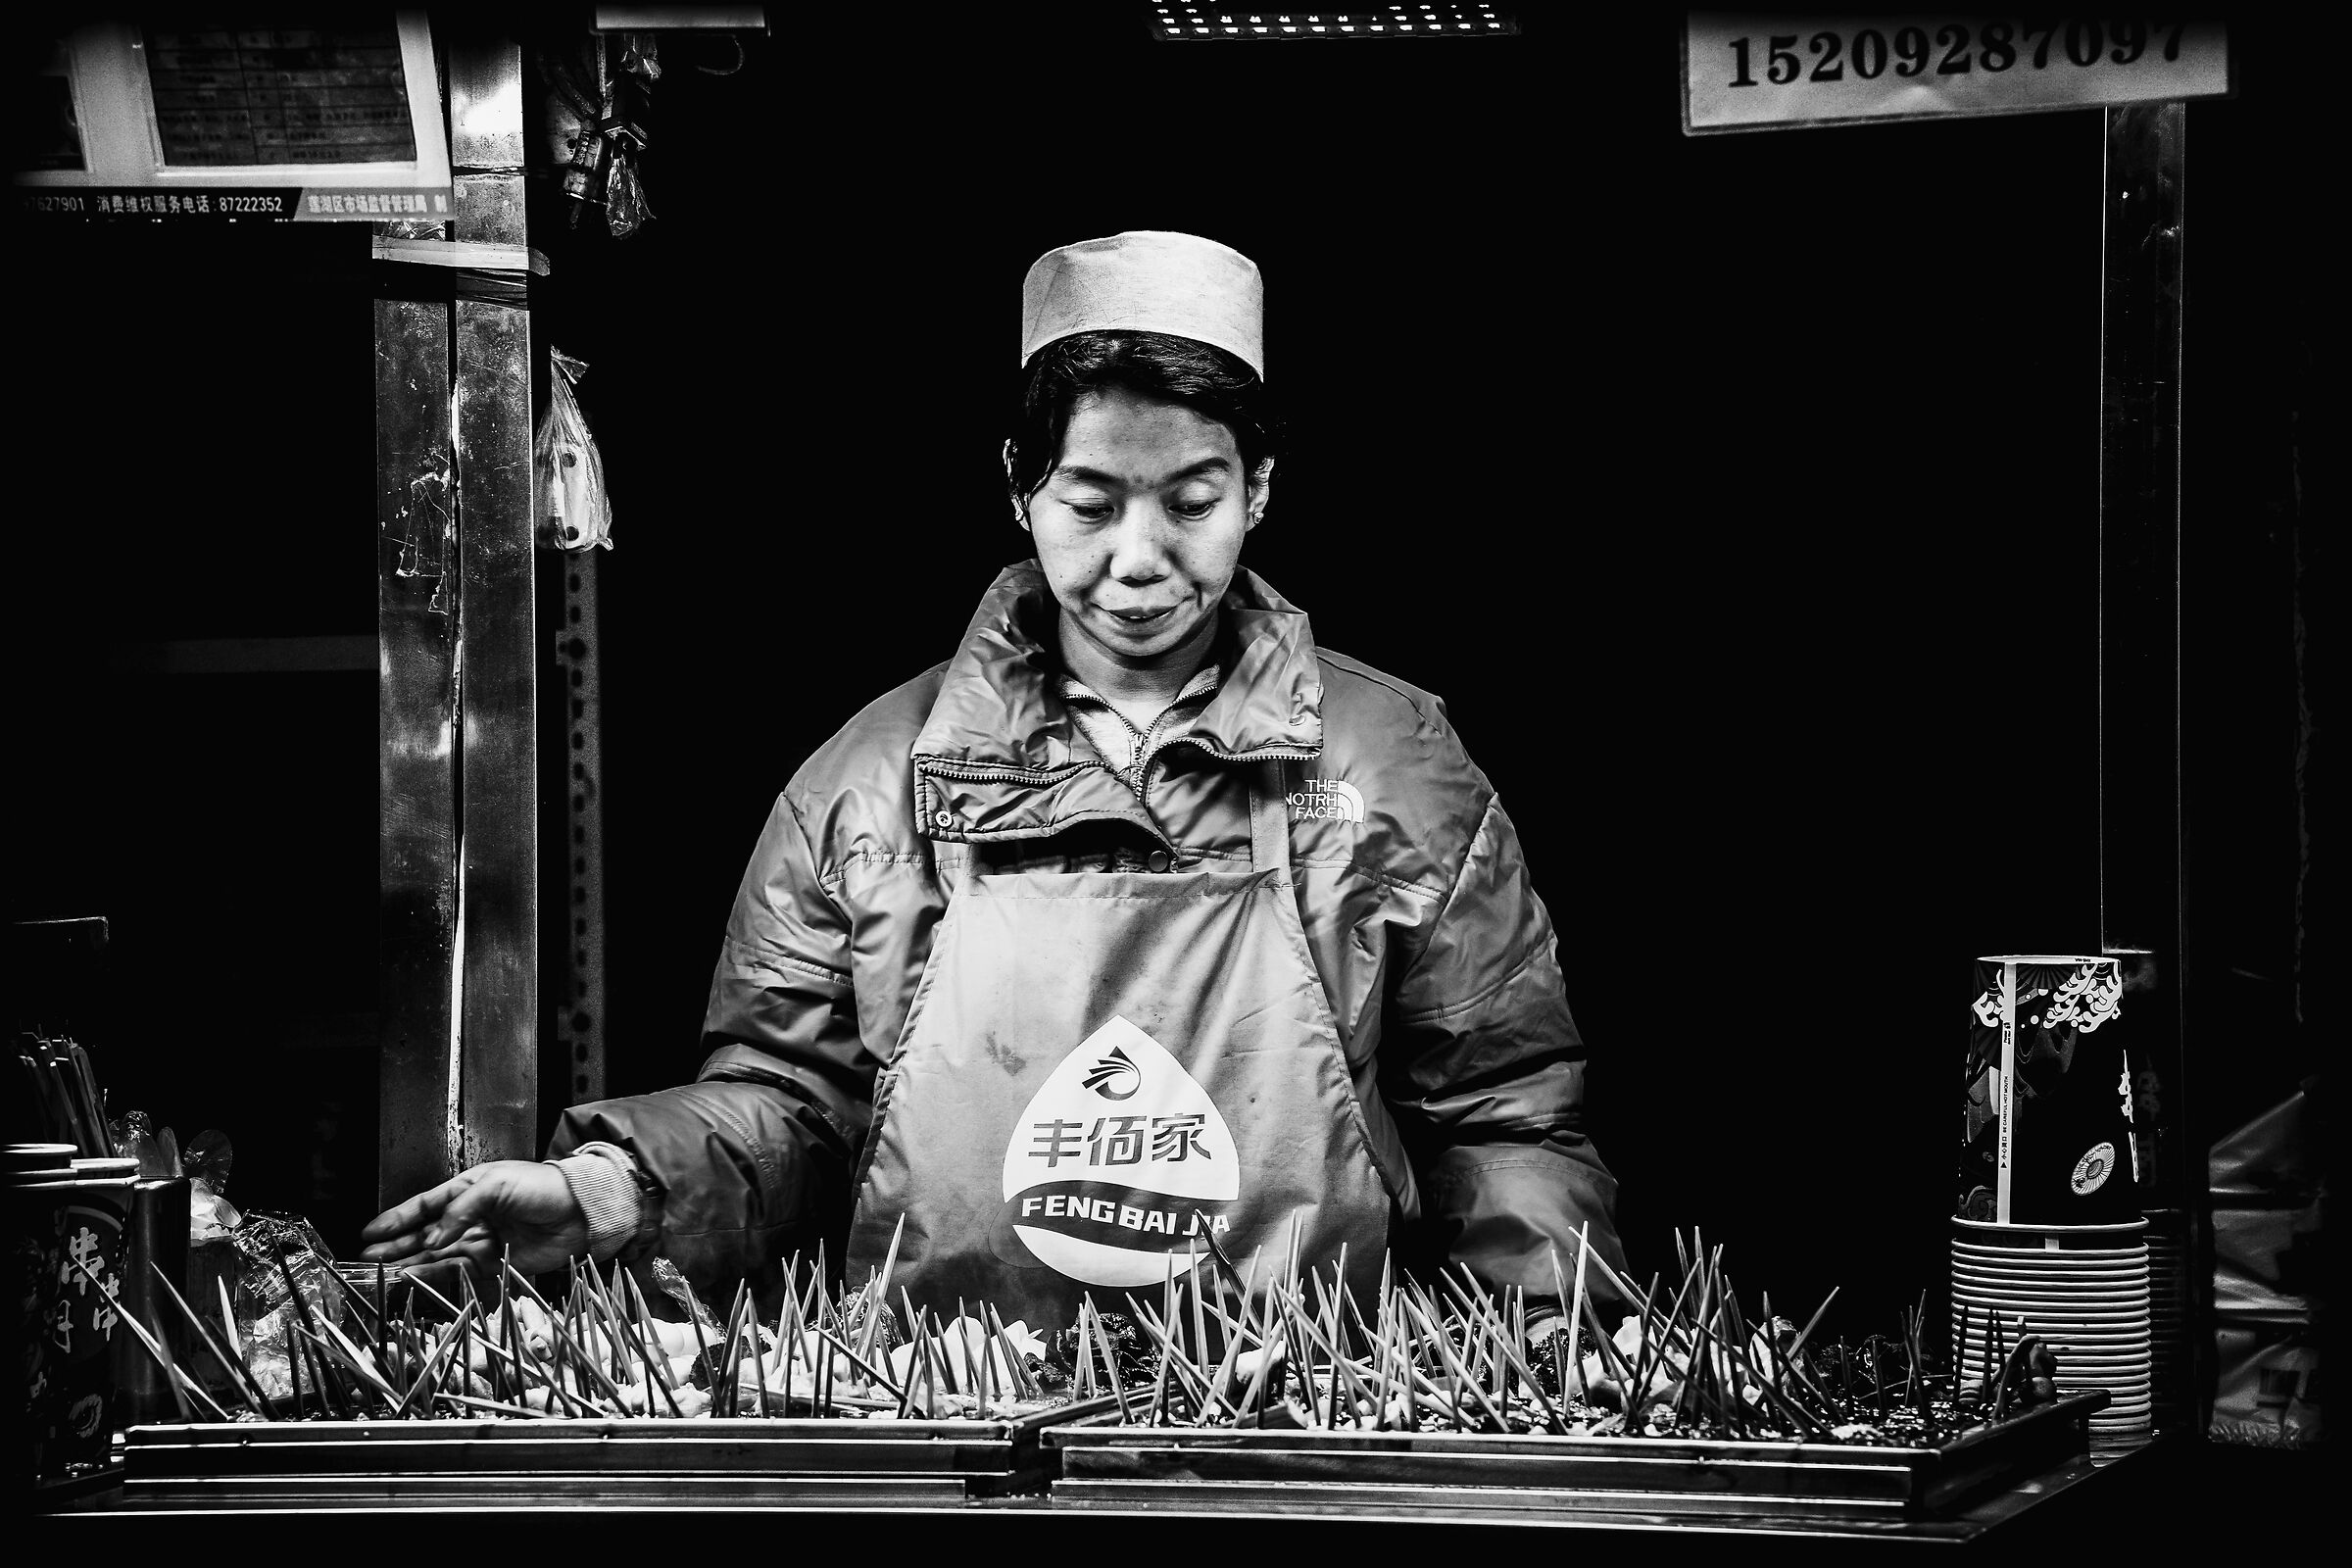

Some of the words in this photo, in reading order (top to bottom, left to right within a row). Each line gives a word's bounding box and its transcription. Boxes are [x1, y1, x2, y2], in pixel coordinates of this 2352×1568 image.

[1728, 19, 2187, 88] 15209287097
[1304, 779, 1338, 793] THE
[1295, 807, 1338, 820] FACE
[1027, 1113, 1212, 1168] 丰佰家
[1021, 1195, 1116, 1223] FENG
[1118, 1203, 1178, 1235] BAI
